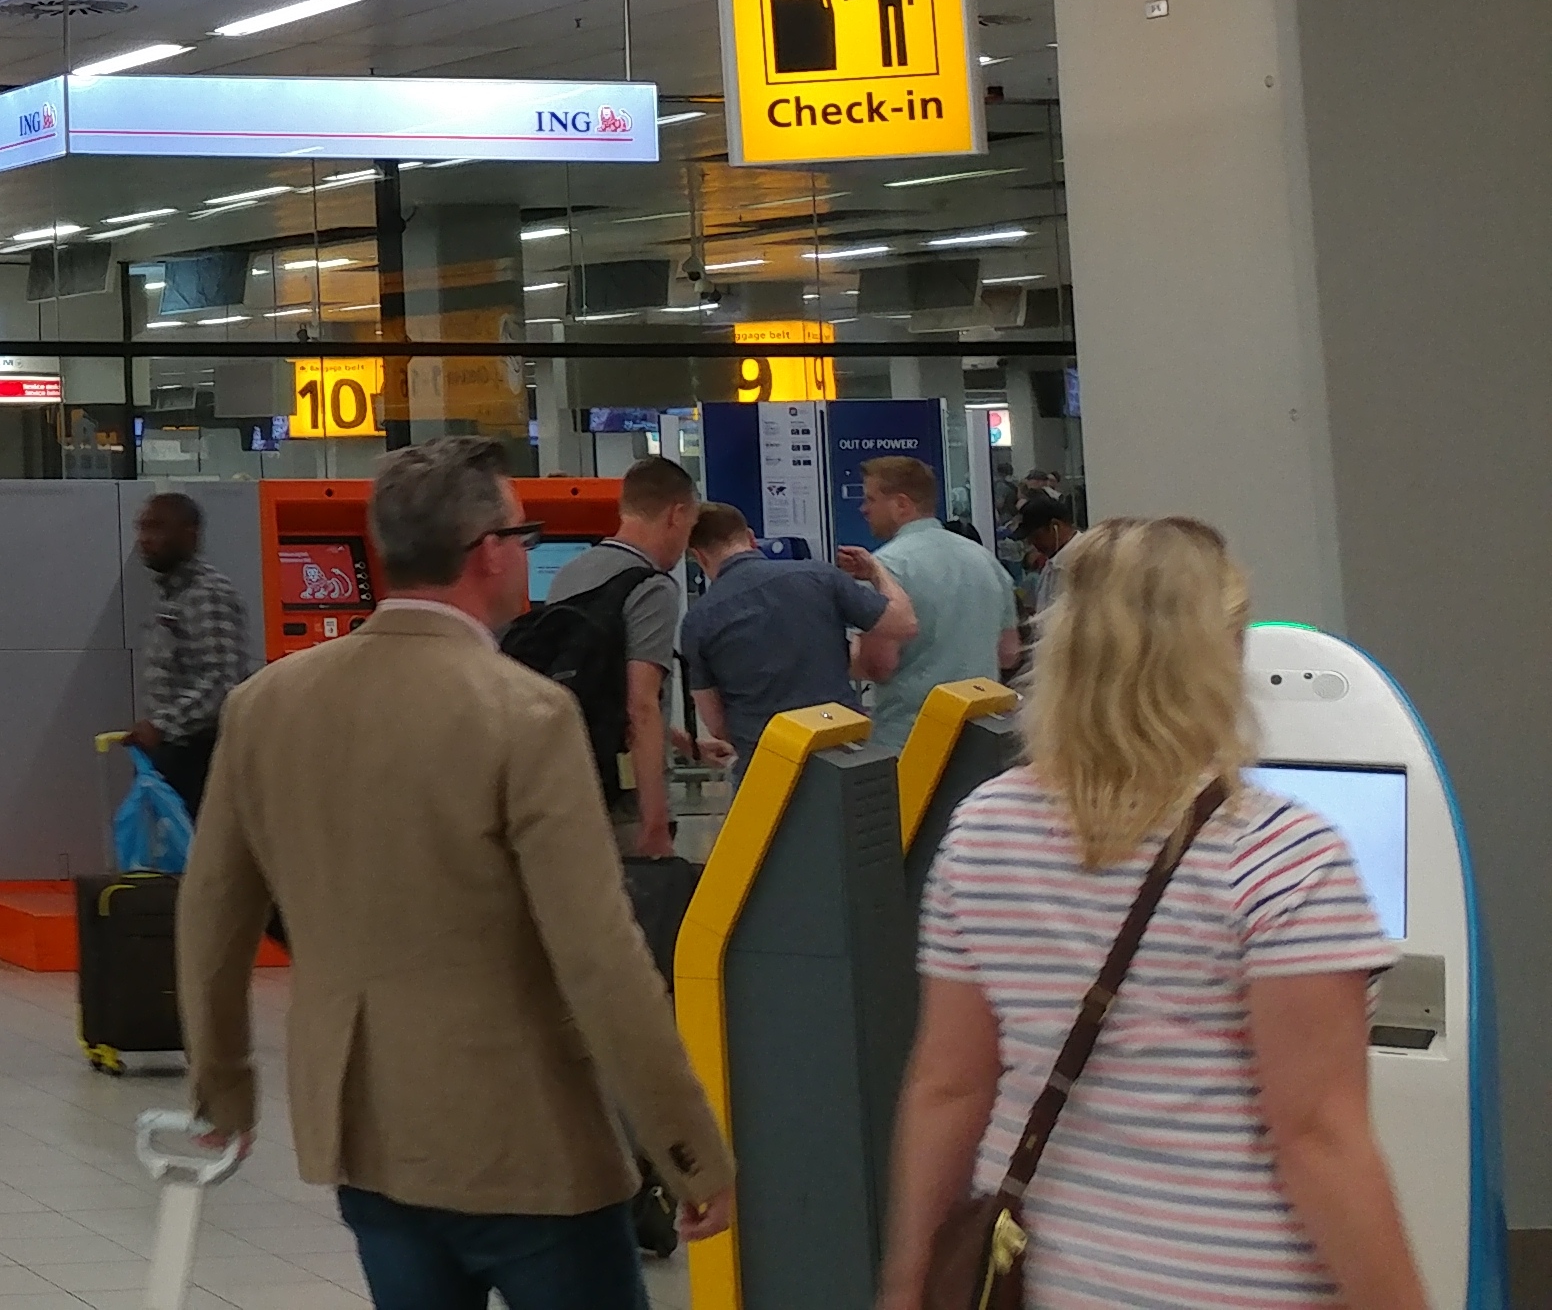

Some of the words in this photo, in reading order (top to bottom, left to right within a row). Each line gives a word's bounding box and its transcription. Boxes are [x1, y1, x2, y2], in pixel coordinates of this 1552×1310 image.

[767, 90, 944, 128] Check-in
[19, 111, 41, 137] ING
[536, 111, 592, 133] ING
[735, 332, 766, 341] ggage
[298, 378, 368, 430] 10
[839, 438, 859, 449] OUT
[861, 438, 875, 449] OF
[877, 438, 919, 450] POWER?
